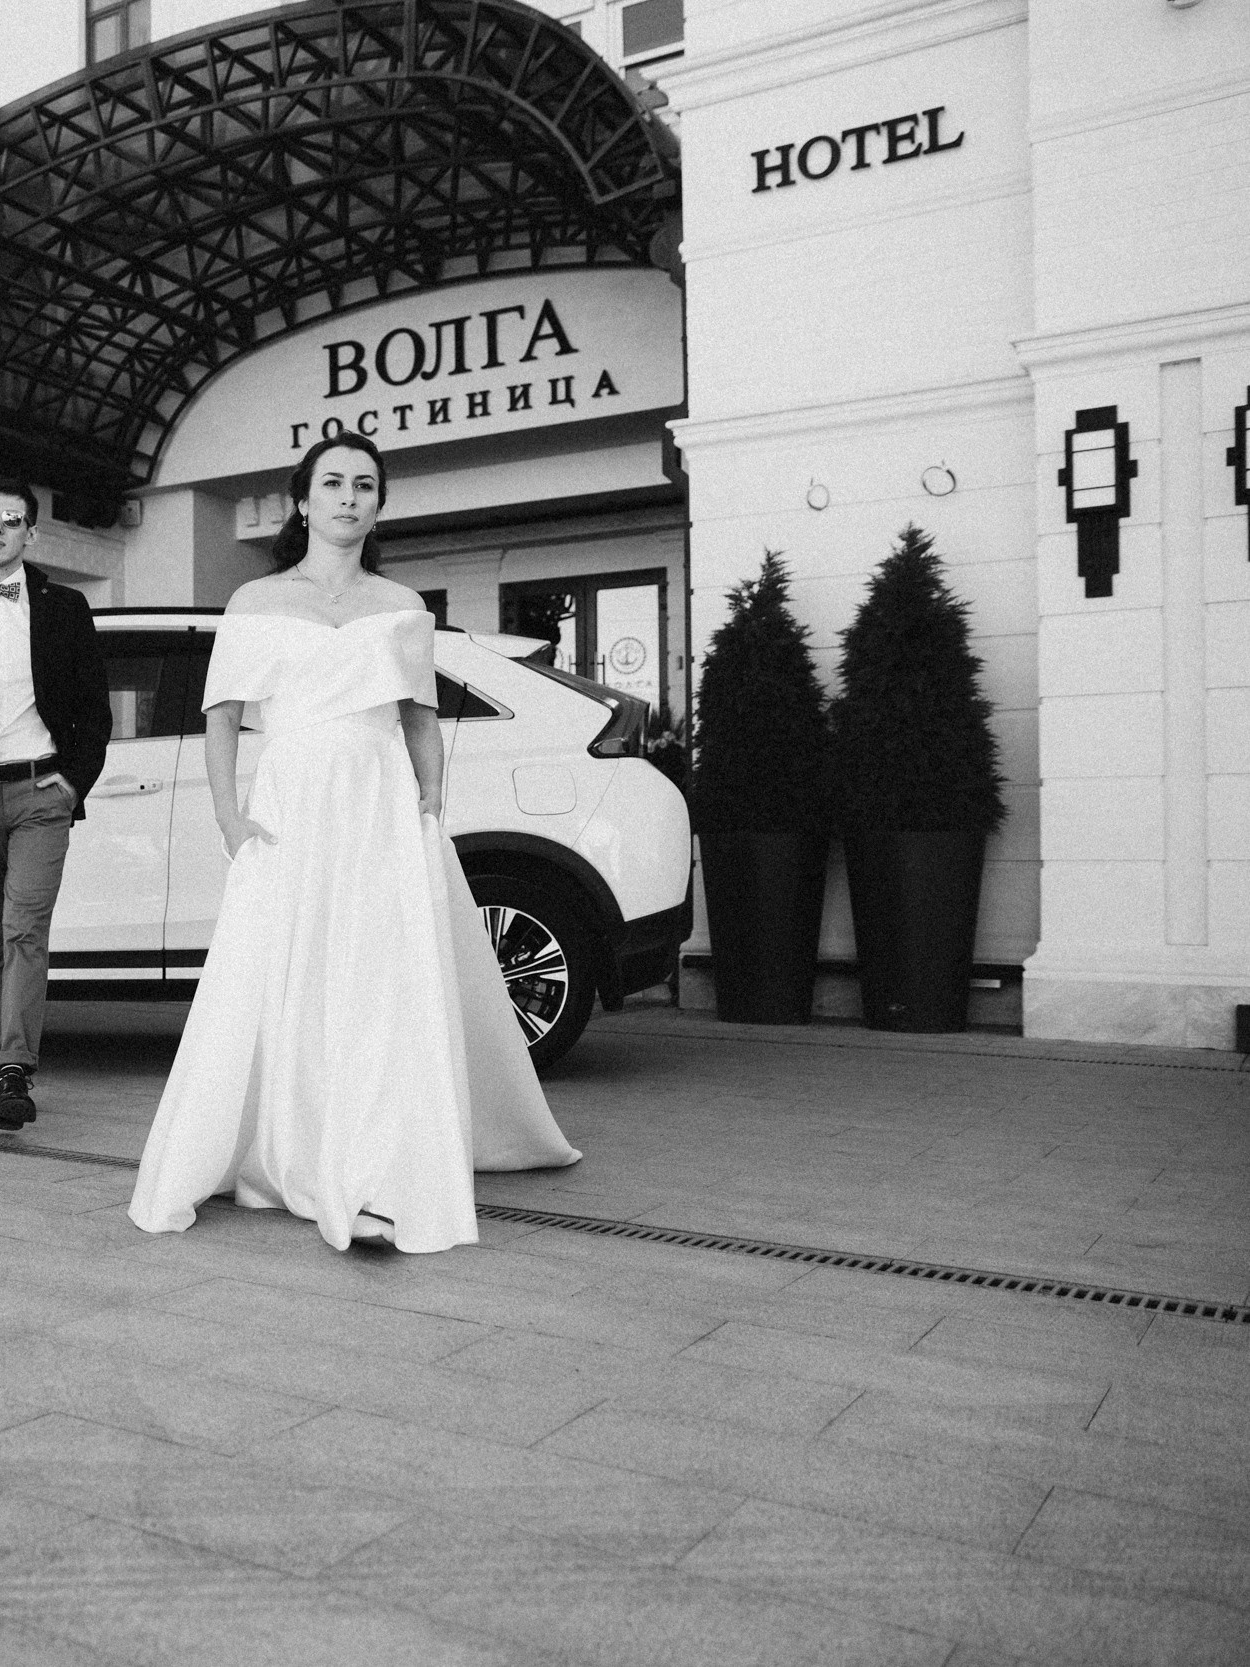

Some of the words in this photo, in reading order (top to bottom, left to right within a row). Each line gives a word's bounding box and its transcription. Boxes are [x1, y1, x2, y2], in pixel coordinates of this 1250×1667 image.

[750, 105, 965, 194] HOTEL
[322, 298, 580, 399] ВОЛГА
[290, 368, 621, 449] ГОСТИНИЦА
